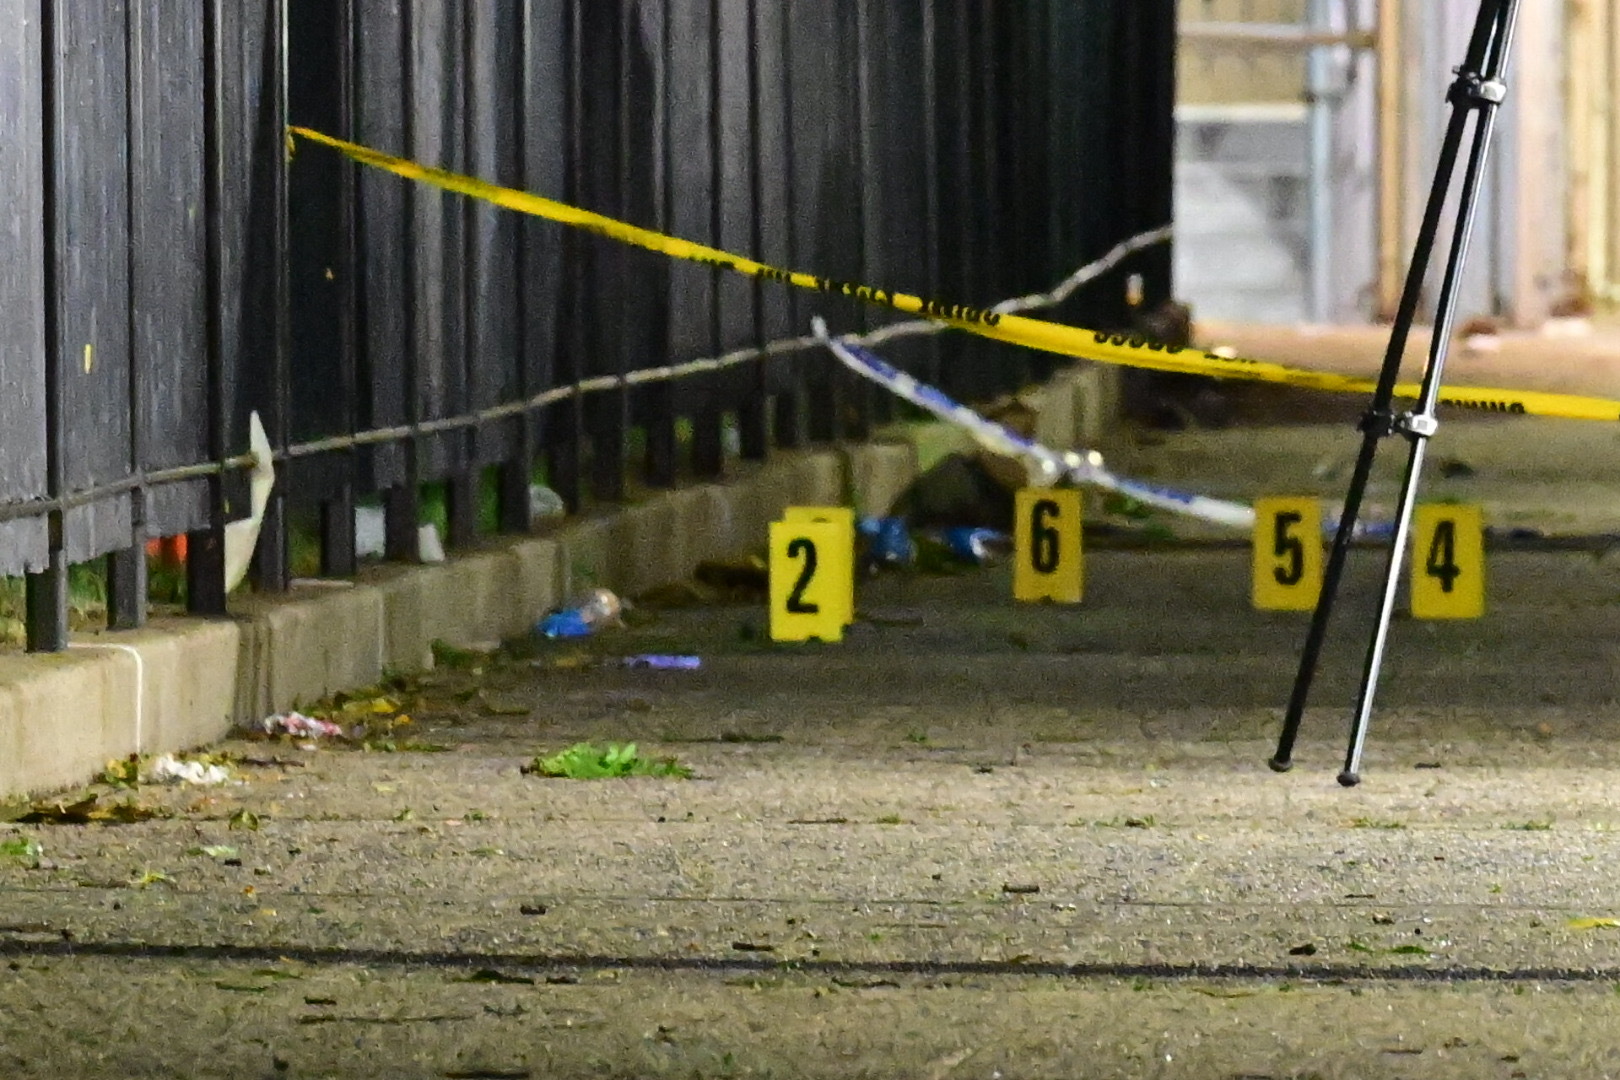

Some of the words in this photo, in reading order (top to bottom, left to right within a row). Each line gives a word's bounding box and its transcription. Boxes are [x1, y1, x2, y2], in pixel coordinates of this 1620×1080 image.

[1032, 499, 1061, 574] 6
[1273, 510, 1304, 586] 5
[1426, 519, 1461, 593] 4
[786, 537, 819, 614] 2
